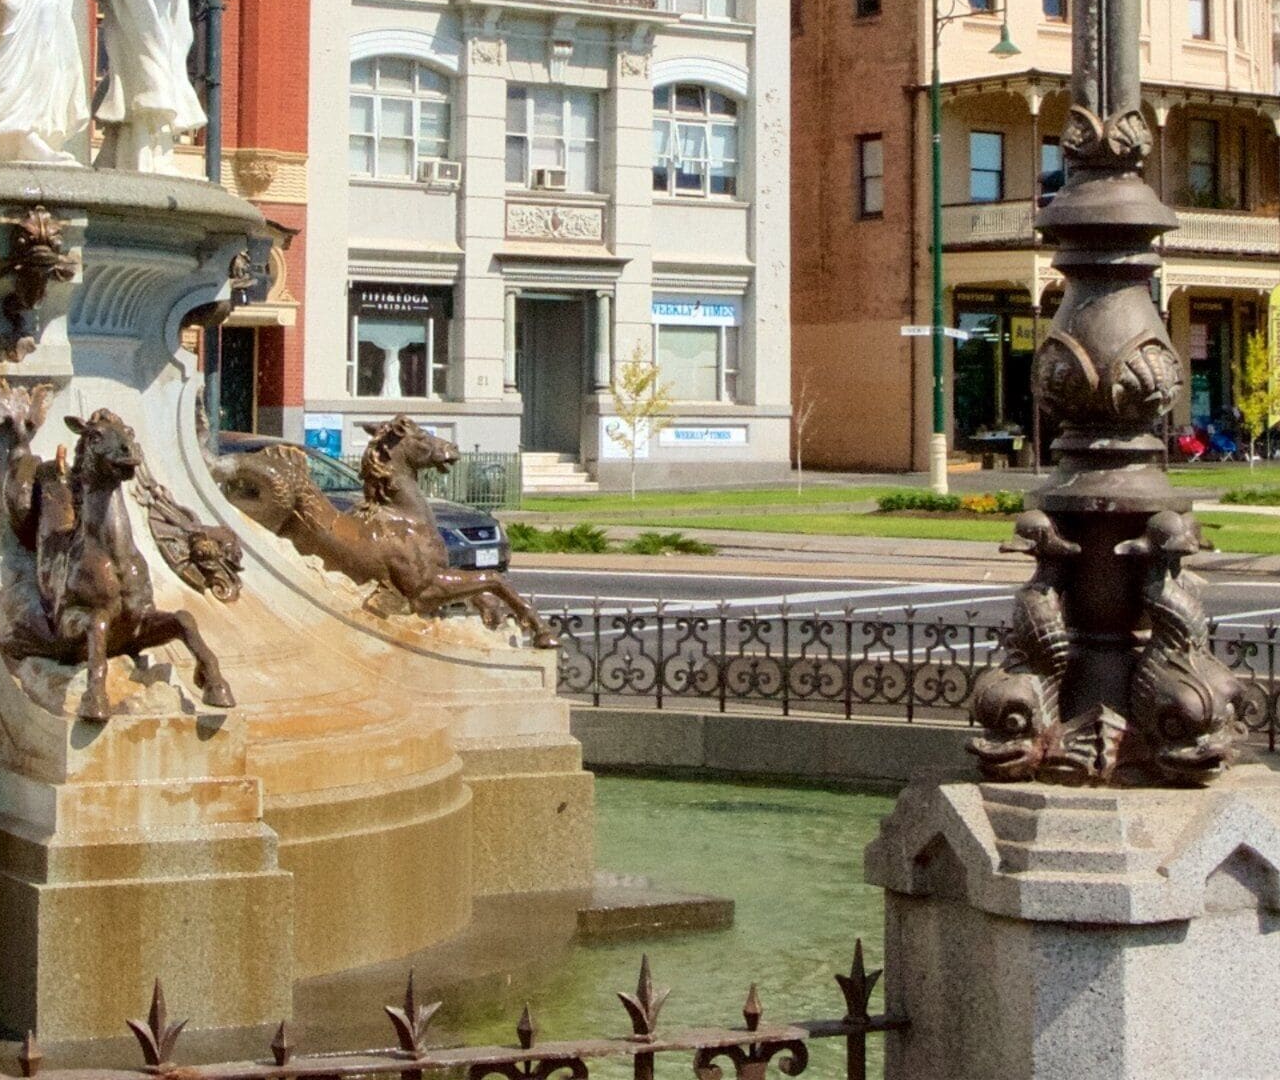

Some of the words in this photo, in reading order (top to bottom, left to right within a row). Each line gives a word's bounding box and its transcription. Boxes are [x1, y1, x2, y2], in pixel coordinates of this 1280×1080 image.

[377, 303, 412, 311] BRIDAL
[702, 303, 736, 318] TIMES
[674, 430, 704, 440] WEEKLY
[709, 431, 731, 440] TIMES
